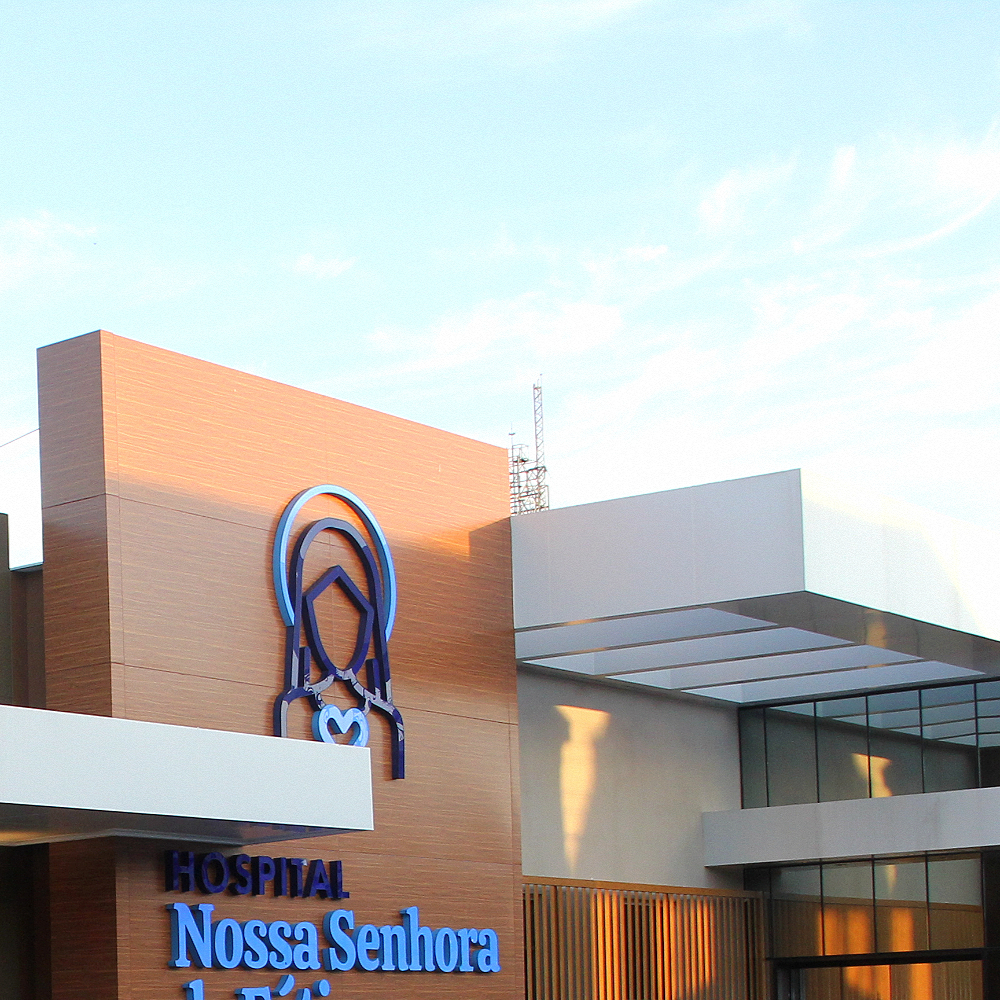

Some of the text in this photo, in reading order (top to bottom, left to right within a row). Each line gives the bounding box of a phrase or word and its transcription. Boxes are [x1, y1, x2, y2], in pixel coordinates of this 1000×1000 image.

[165, 851, 350, 899] HOSPITAL
[166, 902, 501, 973] Nossa Senhora
